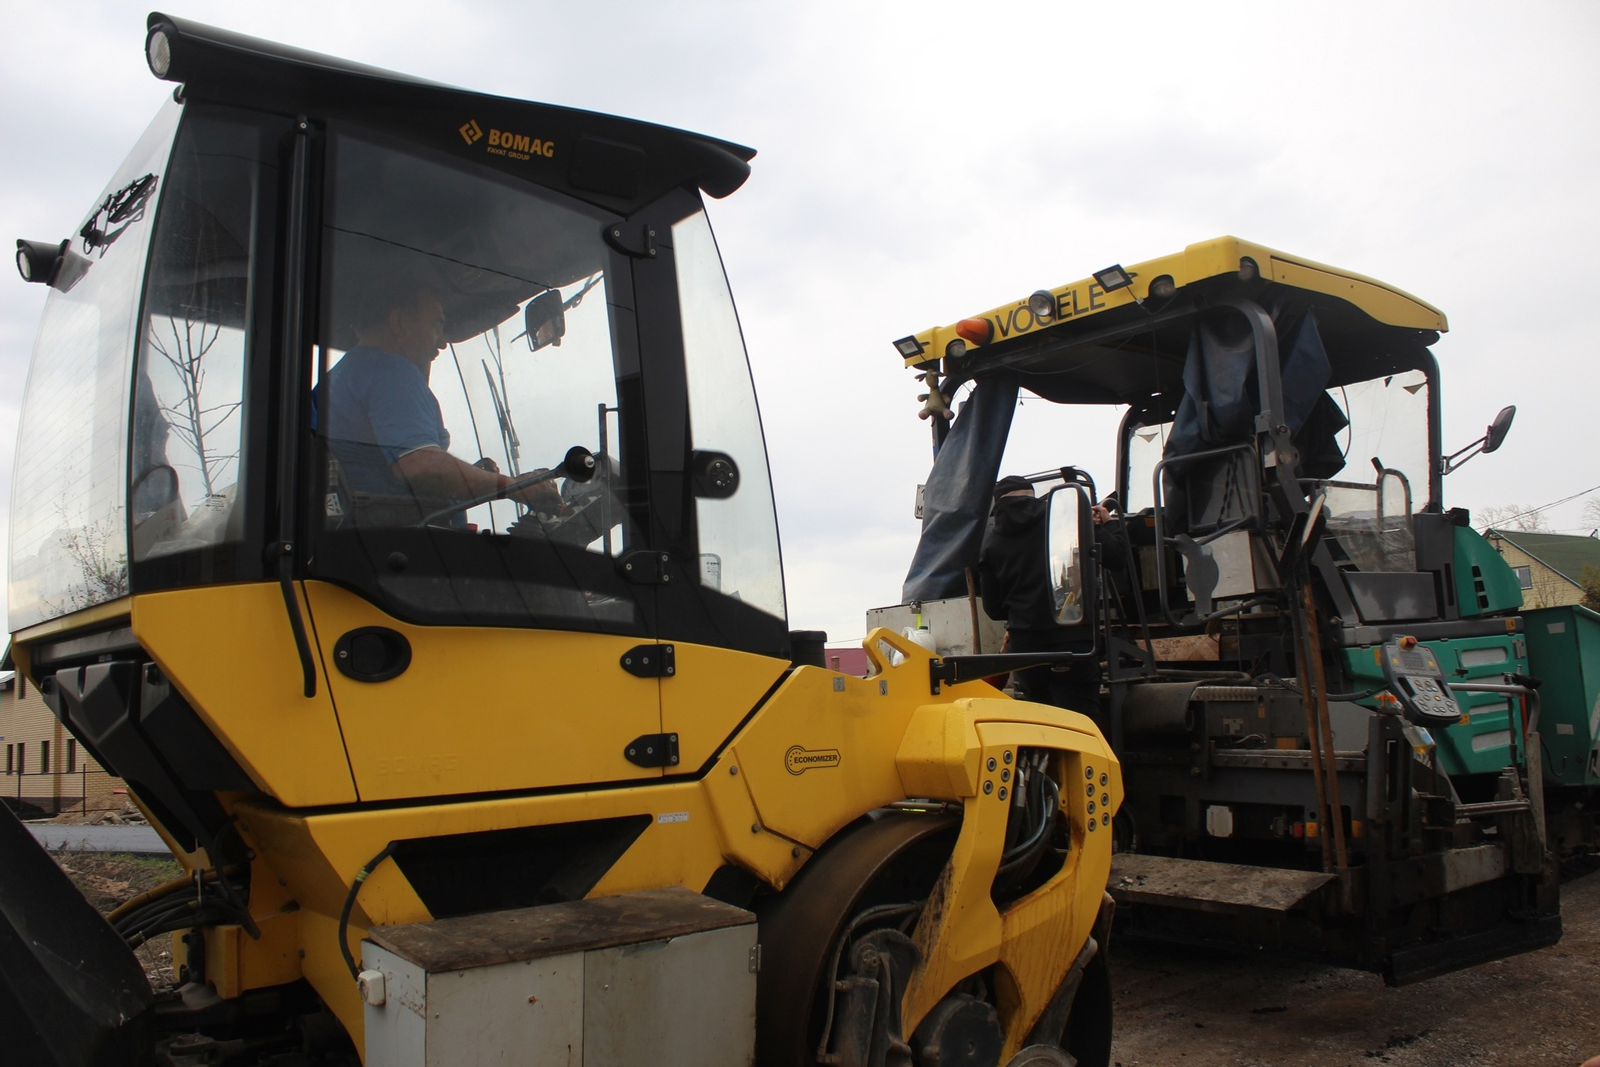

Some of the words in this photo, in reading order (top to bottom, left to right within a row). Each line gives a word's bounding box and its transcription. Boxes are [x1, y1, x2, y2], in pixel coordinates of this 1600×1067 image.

[488, 128, 555, 158] BOMAG
[487, 147, 507, 156] FAYAT
[508, 151, 531, 161] GROUP
[794, 754, 838, 764] ECONOMIZER
